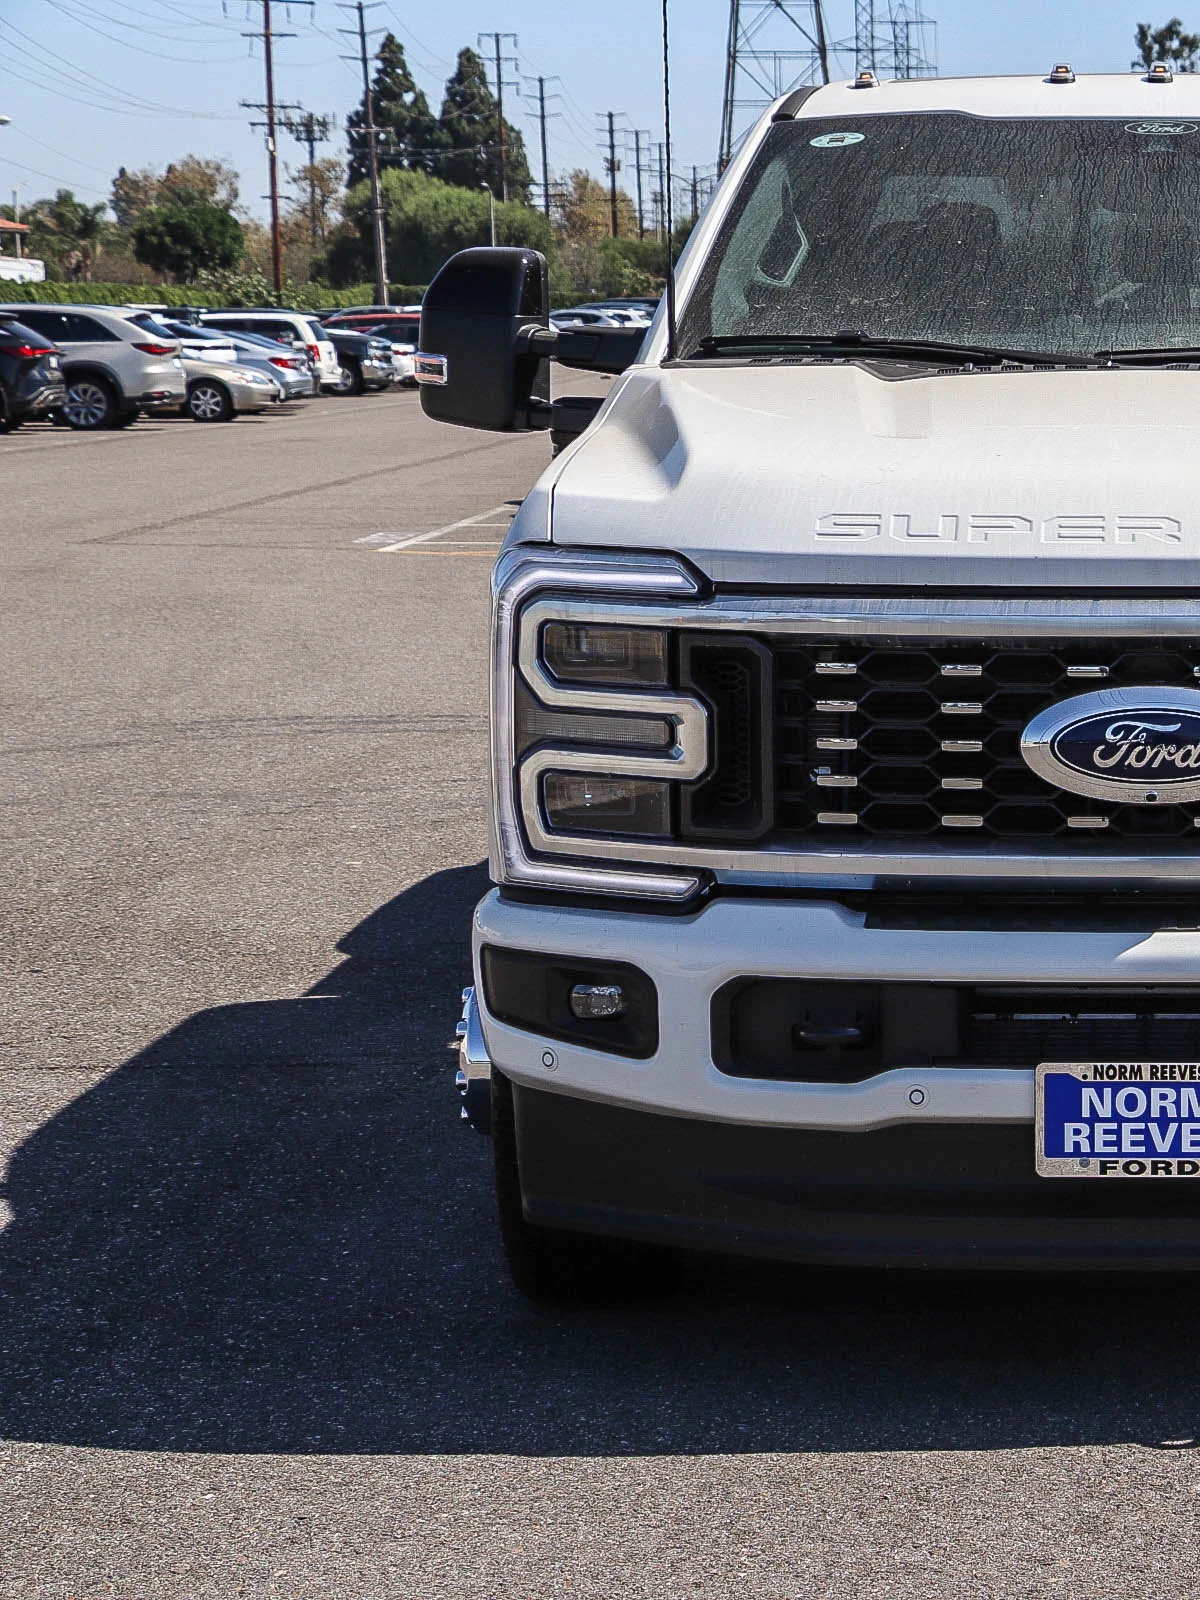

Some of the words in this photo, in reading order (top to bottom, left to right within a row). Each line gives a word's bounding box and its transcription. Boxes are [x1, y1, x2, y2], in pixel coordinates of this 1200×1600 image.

[1137, 122, 1185, 133] Ford
[814, 513, 1181, 544] SUPER
[1093, 1064, 1143, 1081] NORM
[1099, 1159, 1200, 1176] FORD
